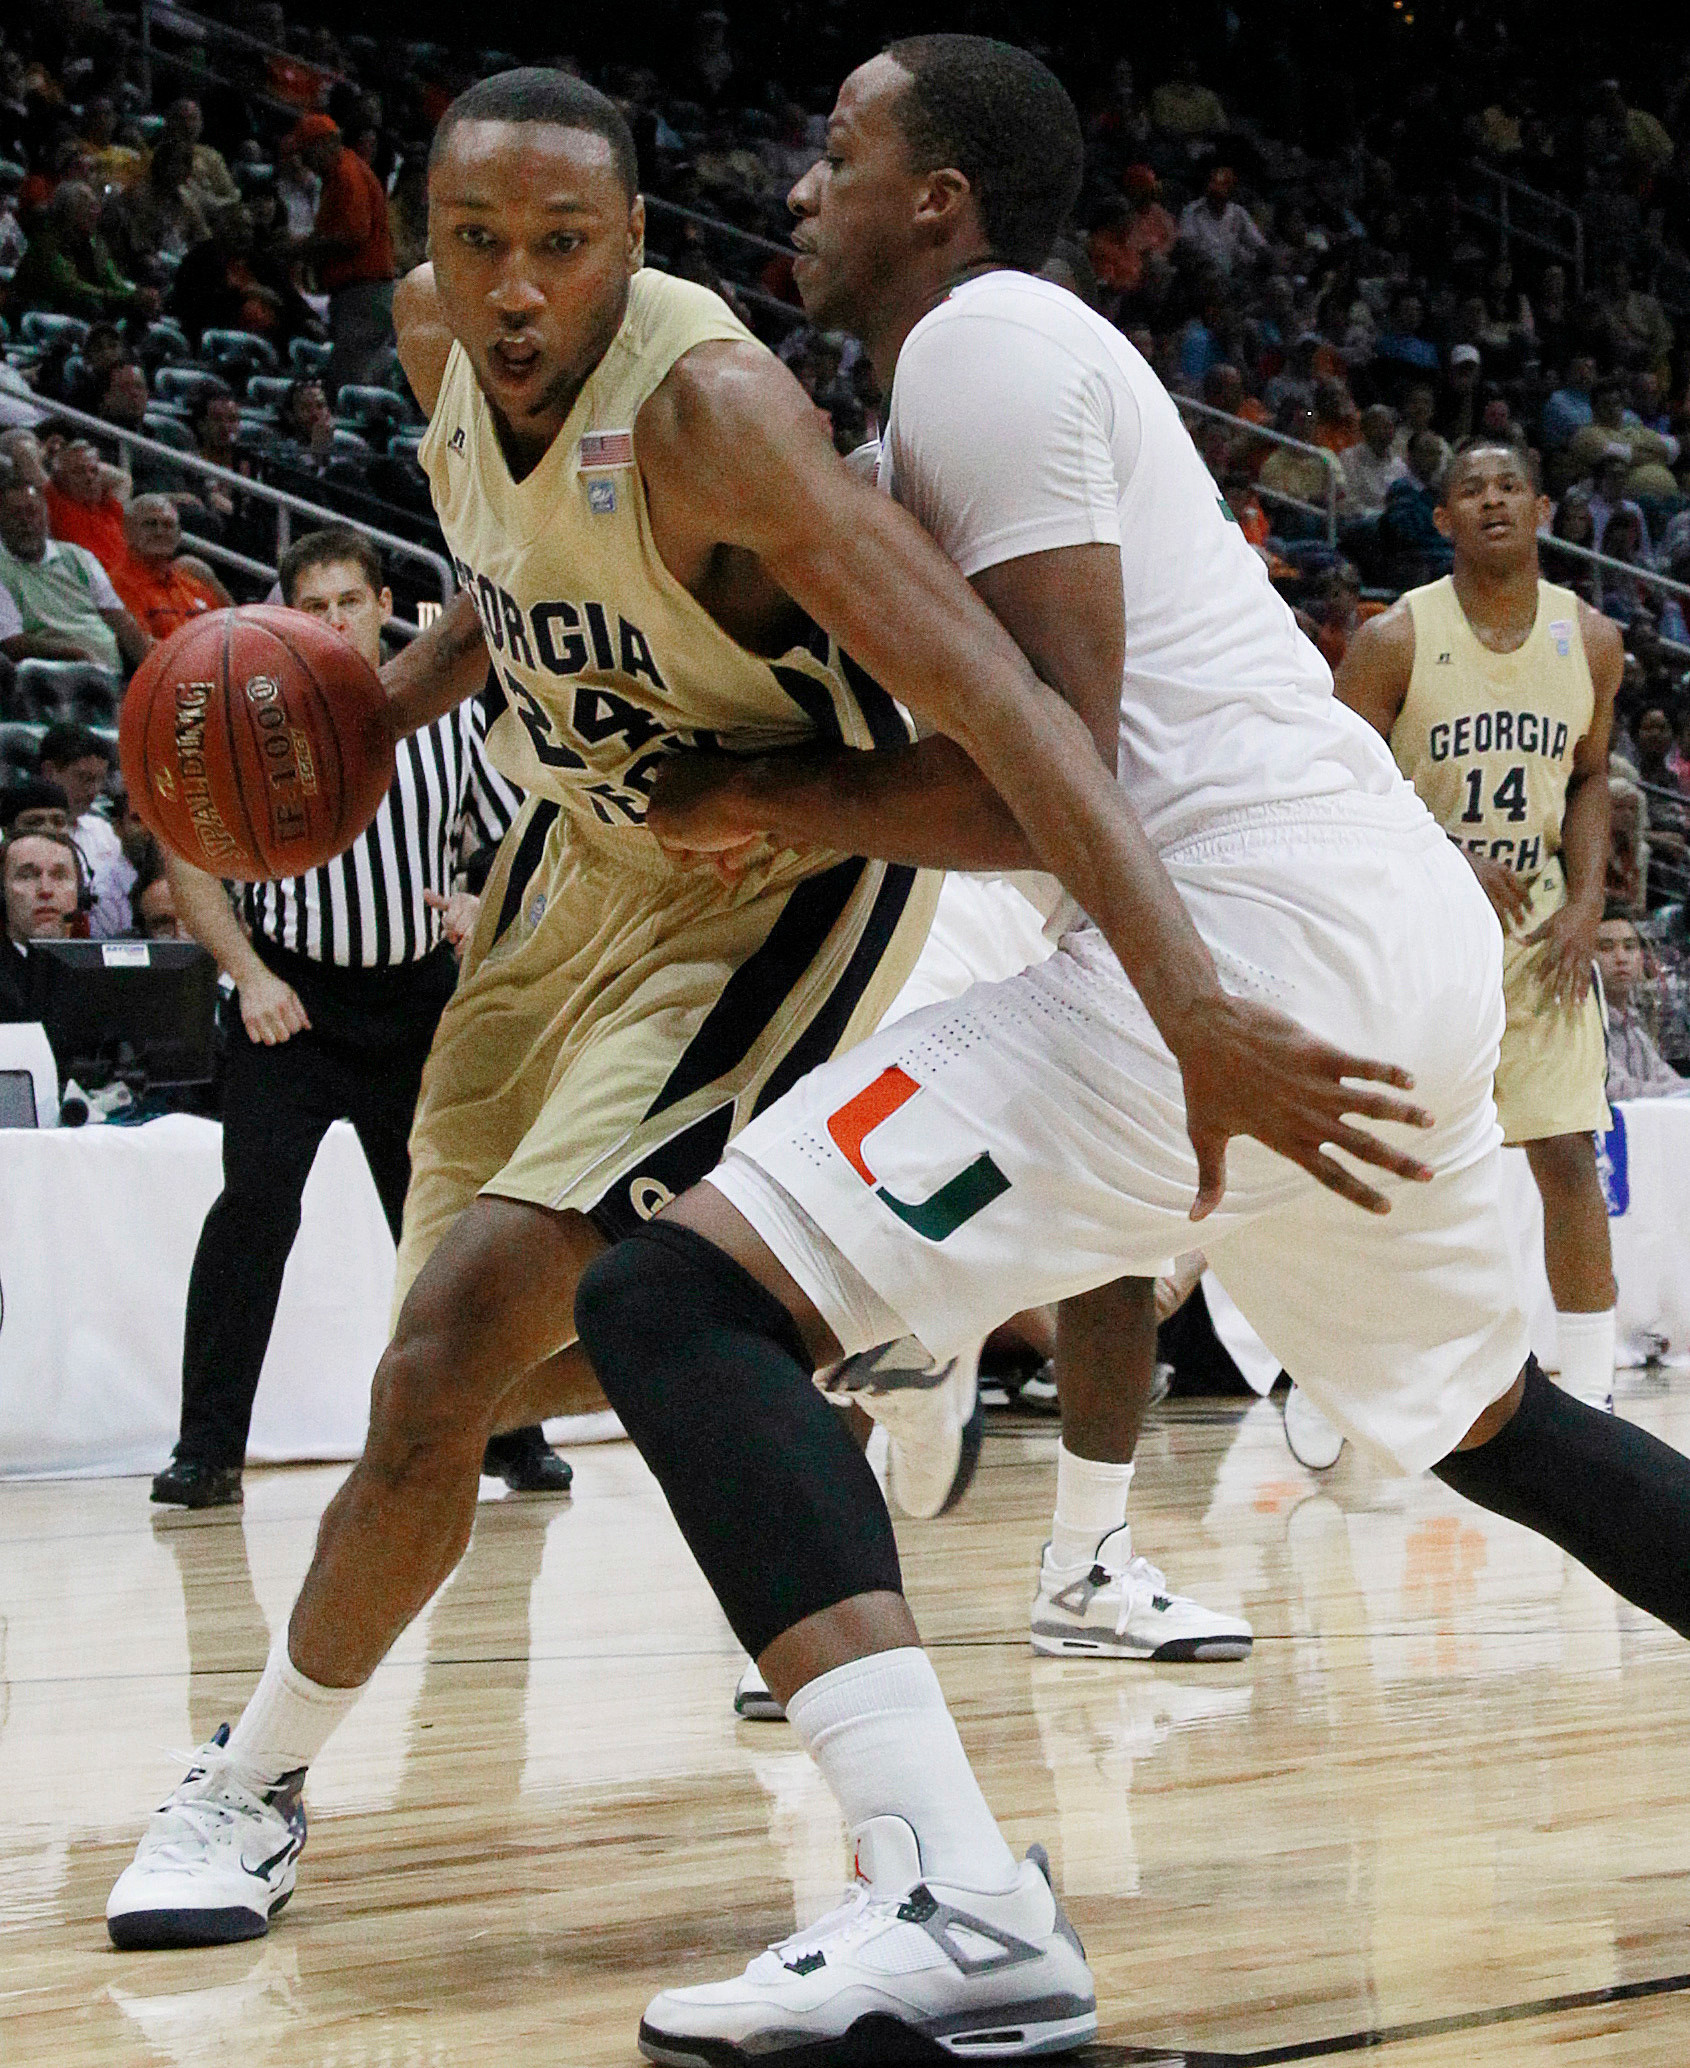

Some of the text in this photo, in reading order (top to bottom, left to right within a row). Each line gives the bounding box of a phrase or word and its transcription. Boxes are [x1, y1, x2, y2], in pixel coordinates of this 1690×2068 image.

[455, 556, 668, 690] ORGIA
[503, 665, 668, 770] 24
[1430, 710, 1568, 762] GEORGIA
[1461, 767, 1527, 822] 14
[1447, 834, 1540, 872] ECH
